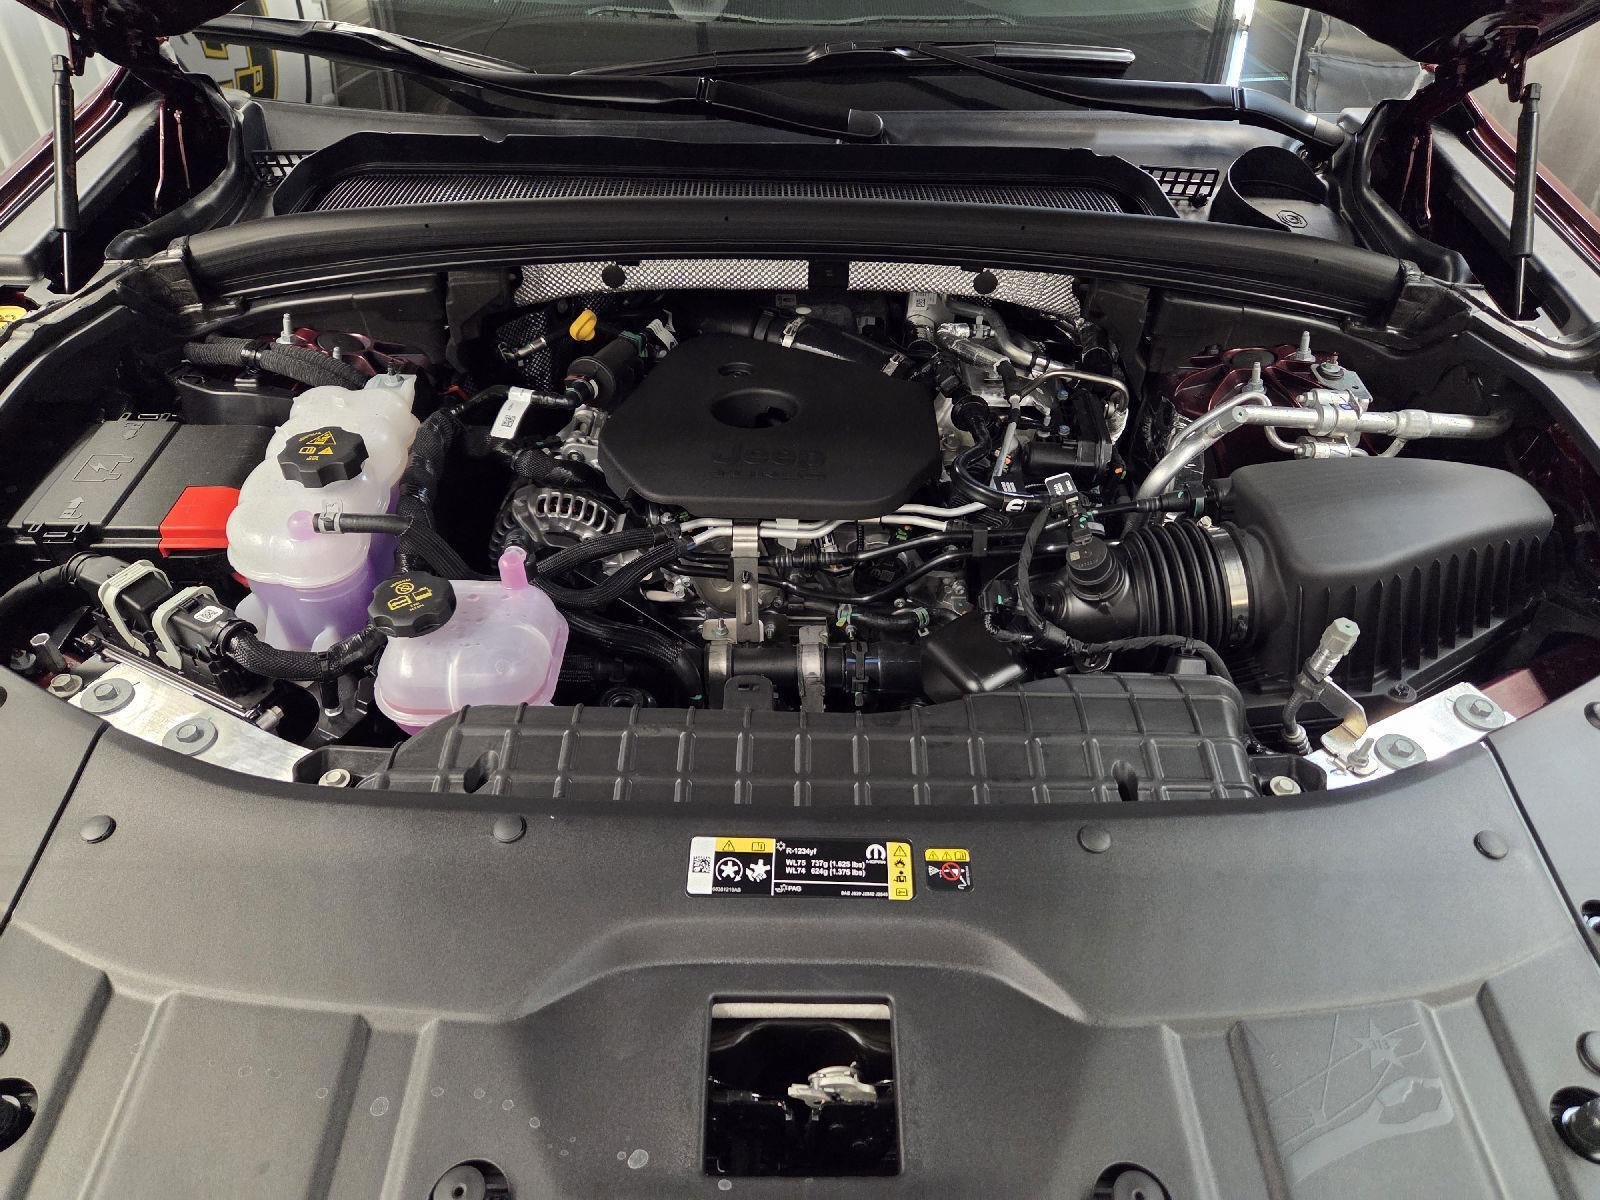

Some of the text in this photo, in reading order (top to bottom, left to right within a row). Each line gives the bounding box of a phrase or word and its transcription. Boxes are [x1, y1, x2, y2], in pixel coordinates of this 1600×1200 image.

[785, 847, 817, 856] R-1234yf
[811, 860, 828, 868] 737g
[852, 861, 866, 870] lbs)
[852, 869, 866, 877] lbs)
